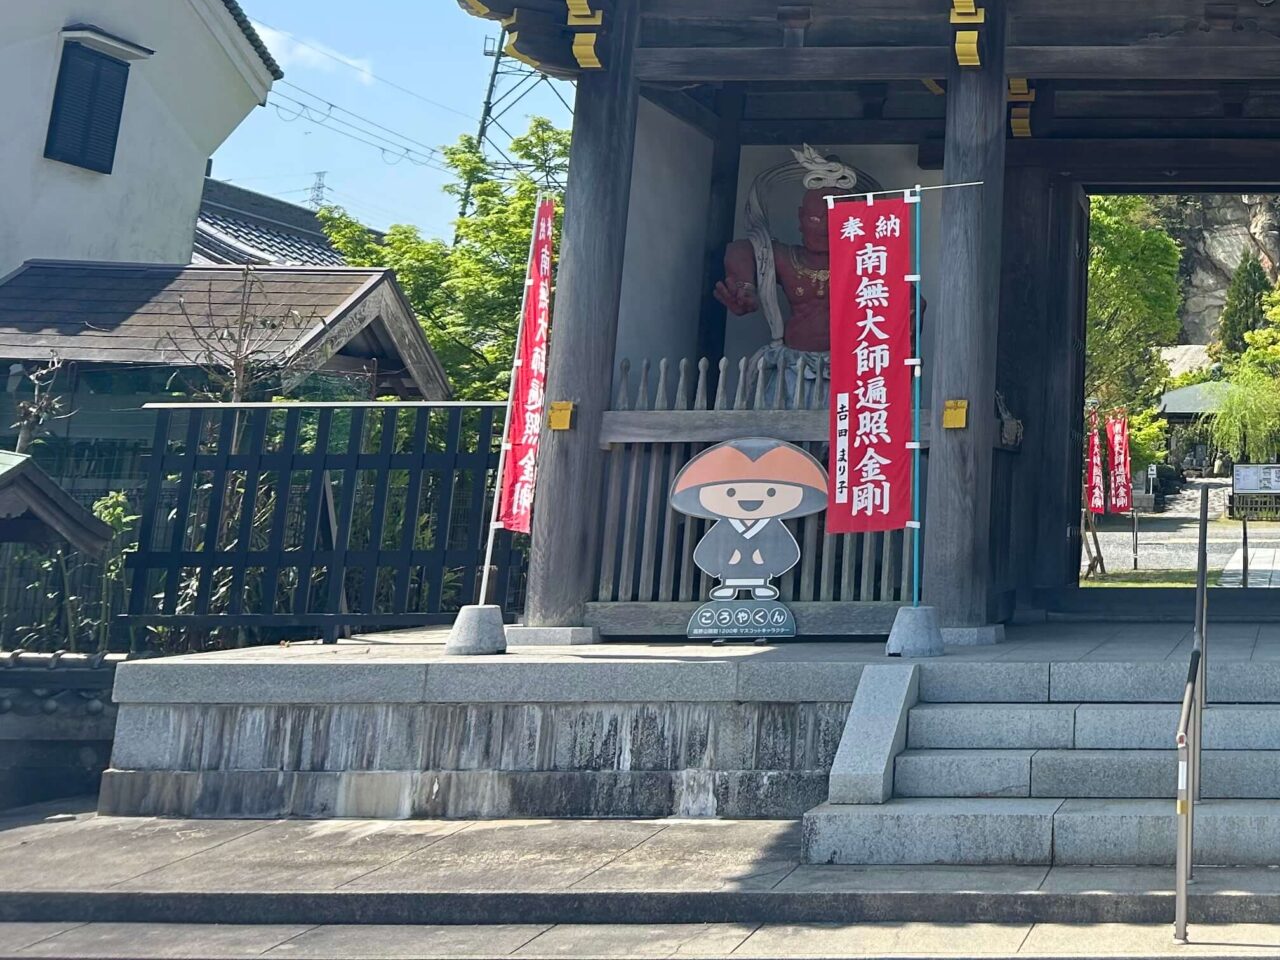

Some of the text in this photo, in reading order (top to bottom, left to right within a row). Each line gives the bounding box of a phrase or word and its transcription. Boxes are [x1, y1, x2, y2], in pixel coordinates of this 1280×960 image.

[840, 215, 901, 242] 奉納
[850, 243, 892, 517] 南無大師遍照金剛
[701, 611, 784, 624] こうやくん
